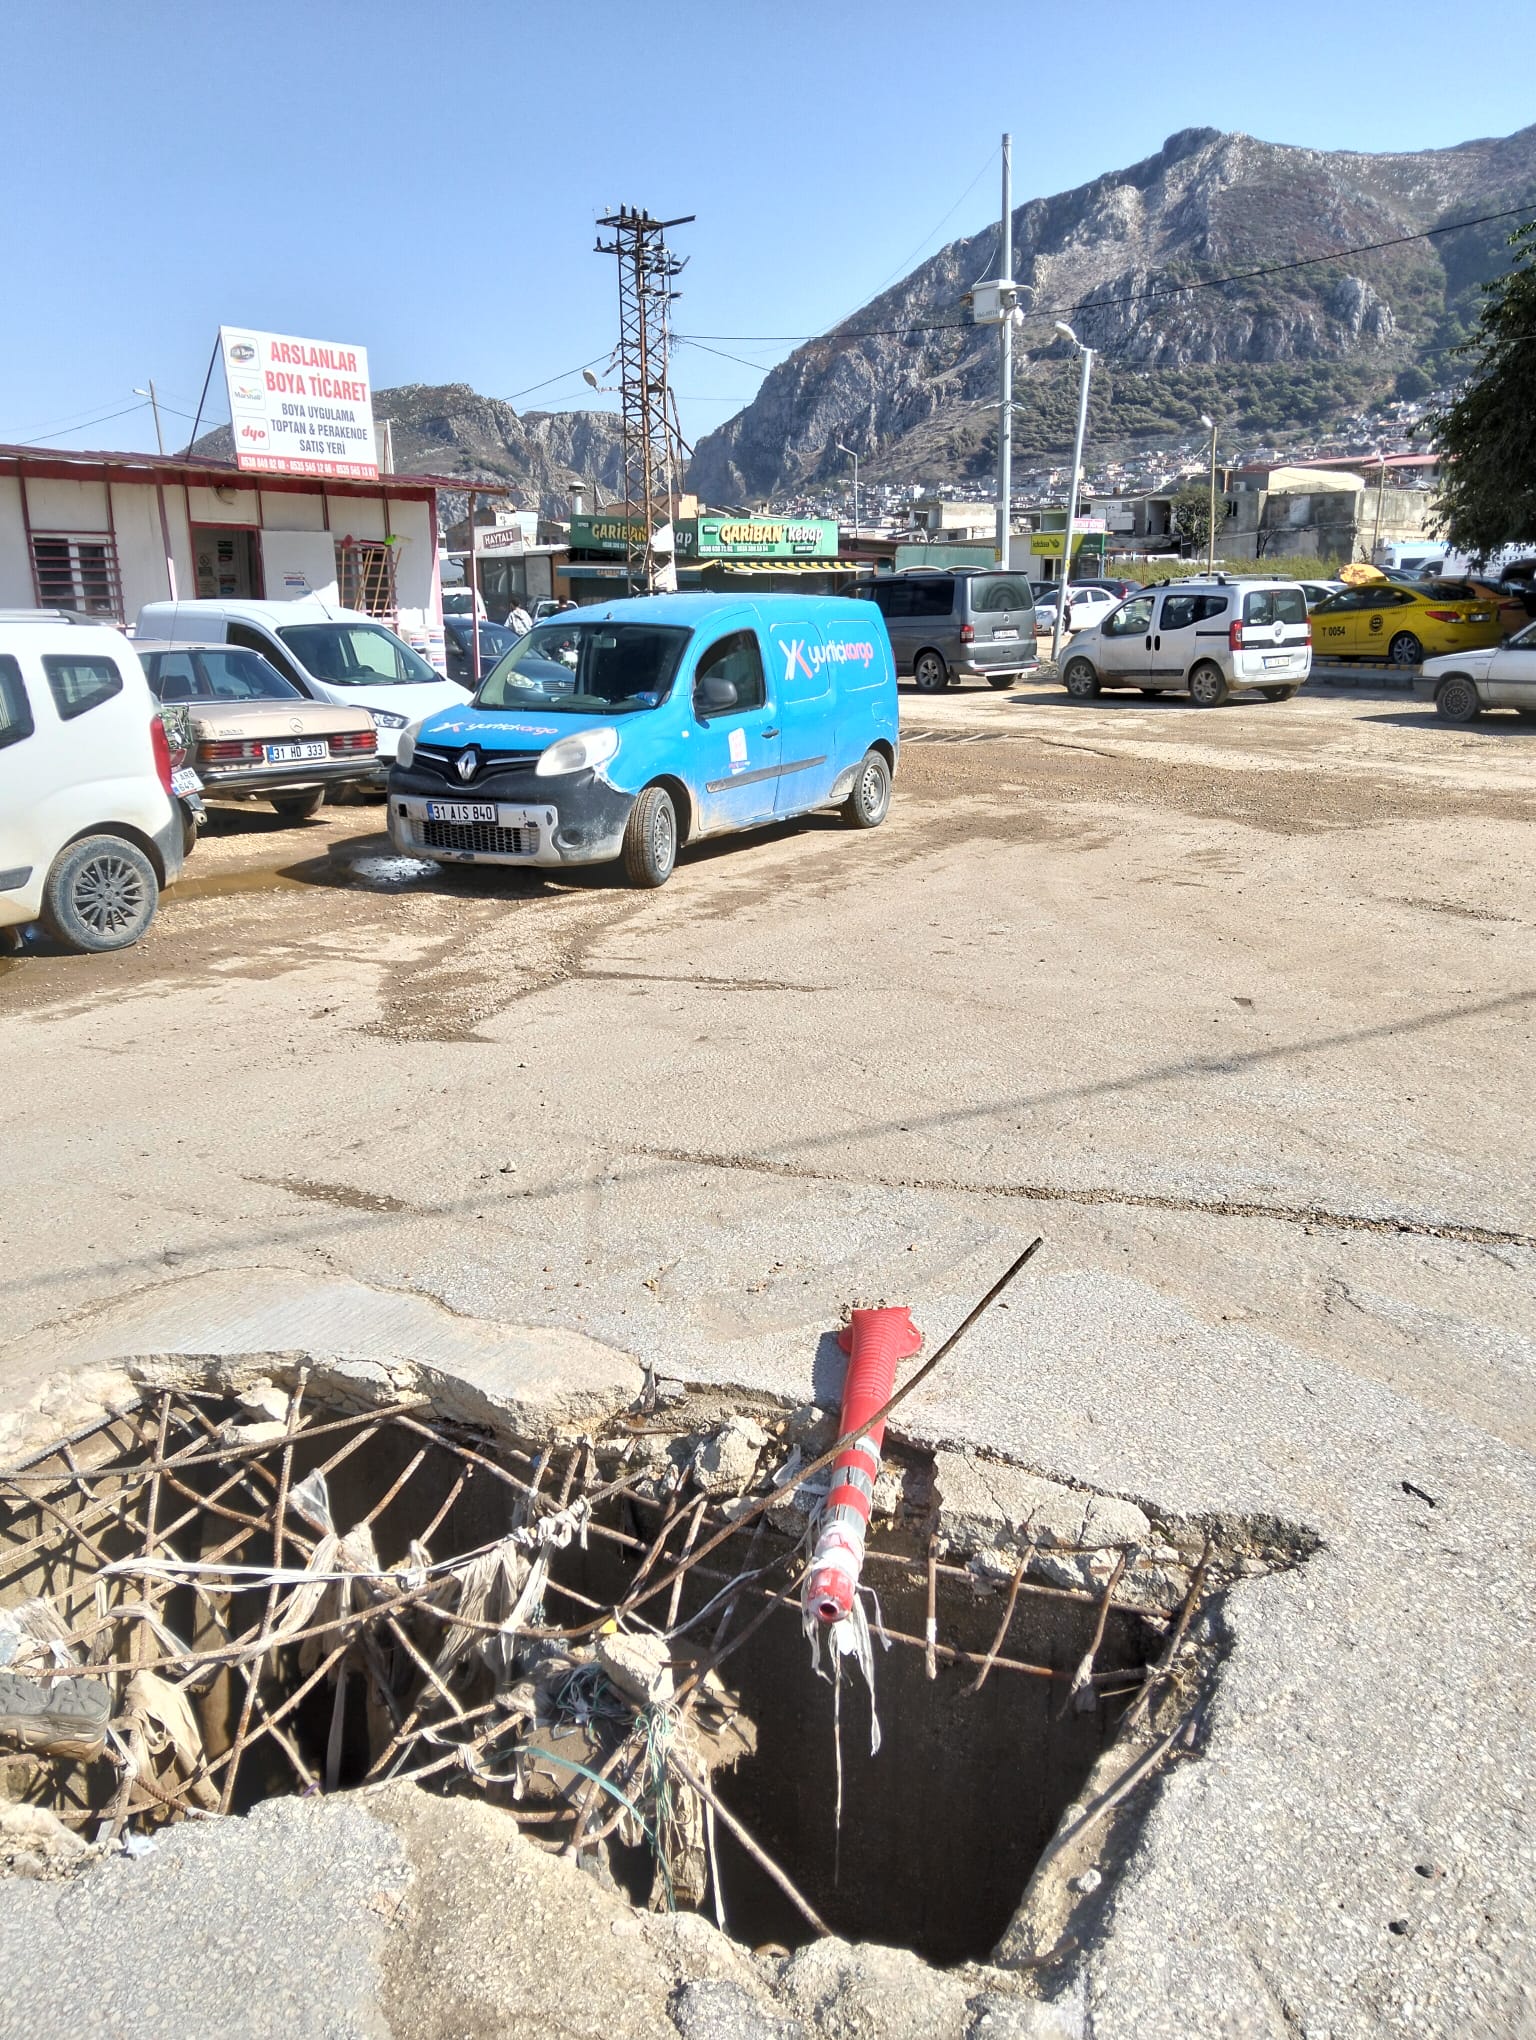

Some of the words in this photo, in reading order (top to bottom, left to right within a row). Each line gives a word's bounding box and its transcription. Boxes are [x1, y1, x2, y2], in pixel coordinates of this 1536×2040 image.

[270, 341, 357, 373] ARSLANLAR
[265, 370, 306, 396] BOYA
[308, 373, 367, 402] TİCARET
[281, 403, 305, 418] BOYA
[308, 406, 355, 423] UYGULAMA
[241, 425, 266, 441] dyo
[271, 419, 307, 435] TOPTAN
[308, 424, 316, 435] &
[317, 425, 368, 441] PERAKENDE
[299, 440, 325, 454] SATIŞ
[326, 441, 346, 455] YERİ
[484, 530, 513, 545] HAYTALI
[787, 526, 824, 545] kebap
[1321, 627, 1328, 637] T
[1328, 626, 1346, 637] 0054
[273, 748, 285, 760] 31
[290, 746, 302, 758] HD
[307, 744, 323, 757] 333
[179, 769, 195, 781] ARB
[178, 779, 195, 792] 645
[433, 805, 446, 819] 31
[450, 806, 469, 820] AIS
[472, 806, 493, 820] 840
